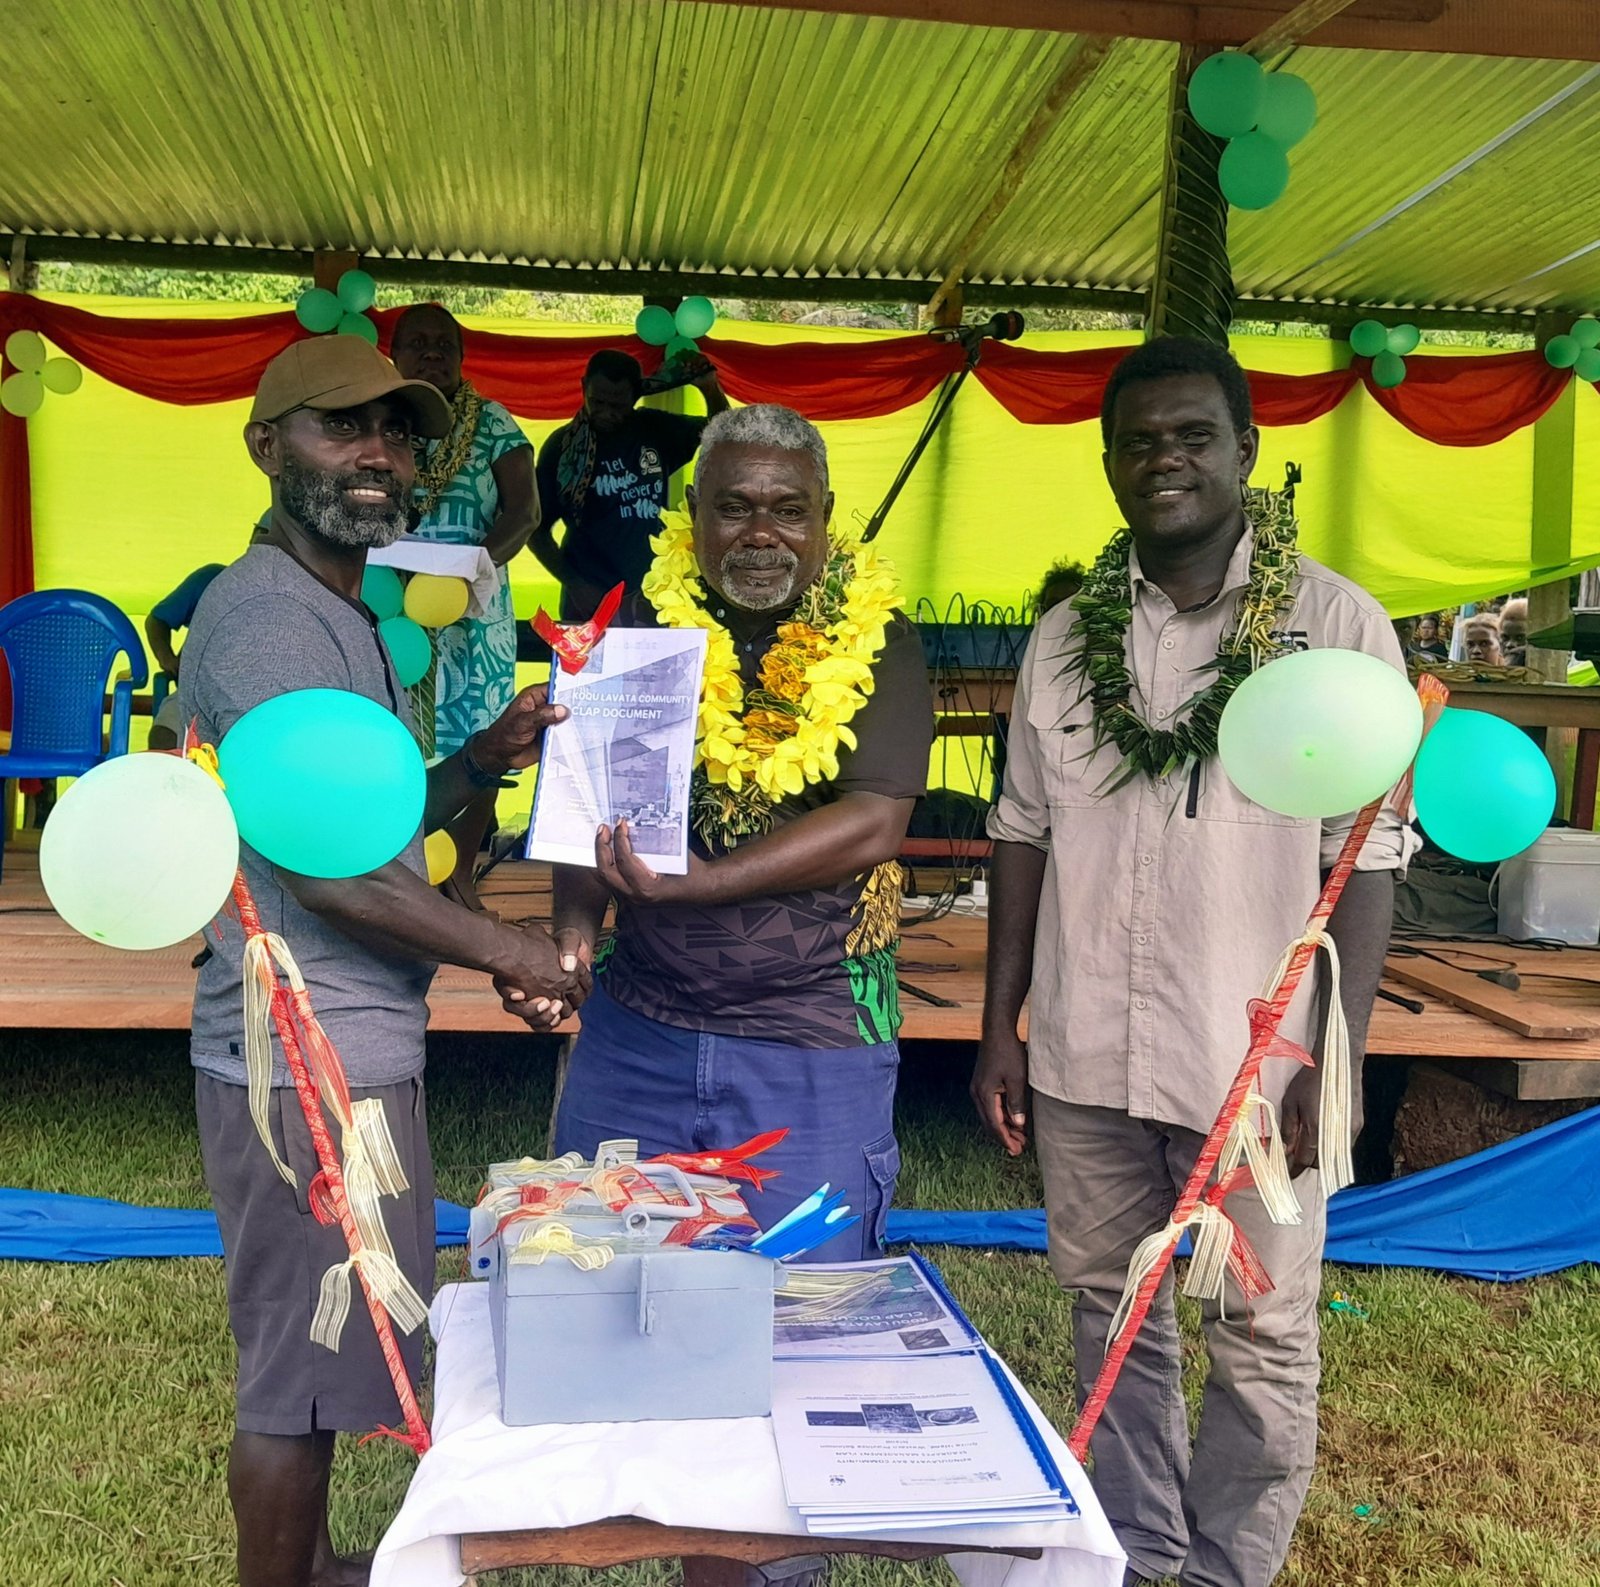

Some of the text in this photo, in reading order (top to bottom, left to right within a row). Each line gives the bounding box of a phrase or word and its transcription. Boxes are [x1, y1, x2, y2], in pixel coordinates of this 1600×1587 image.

[621, 484, 651, 502] never
[600, 692, 636, 703] LAVATA
[638, 694, 692, 705] COMMUNITY
[571, 705, 663, 719] CLAP DOCUMENT
[885, 1311, 923, 1320] CLAP
